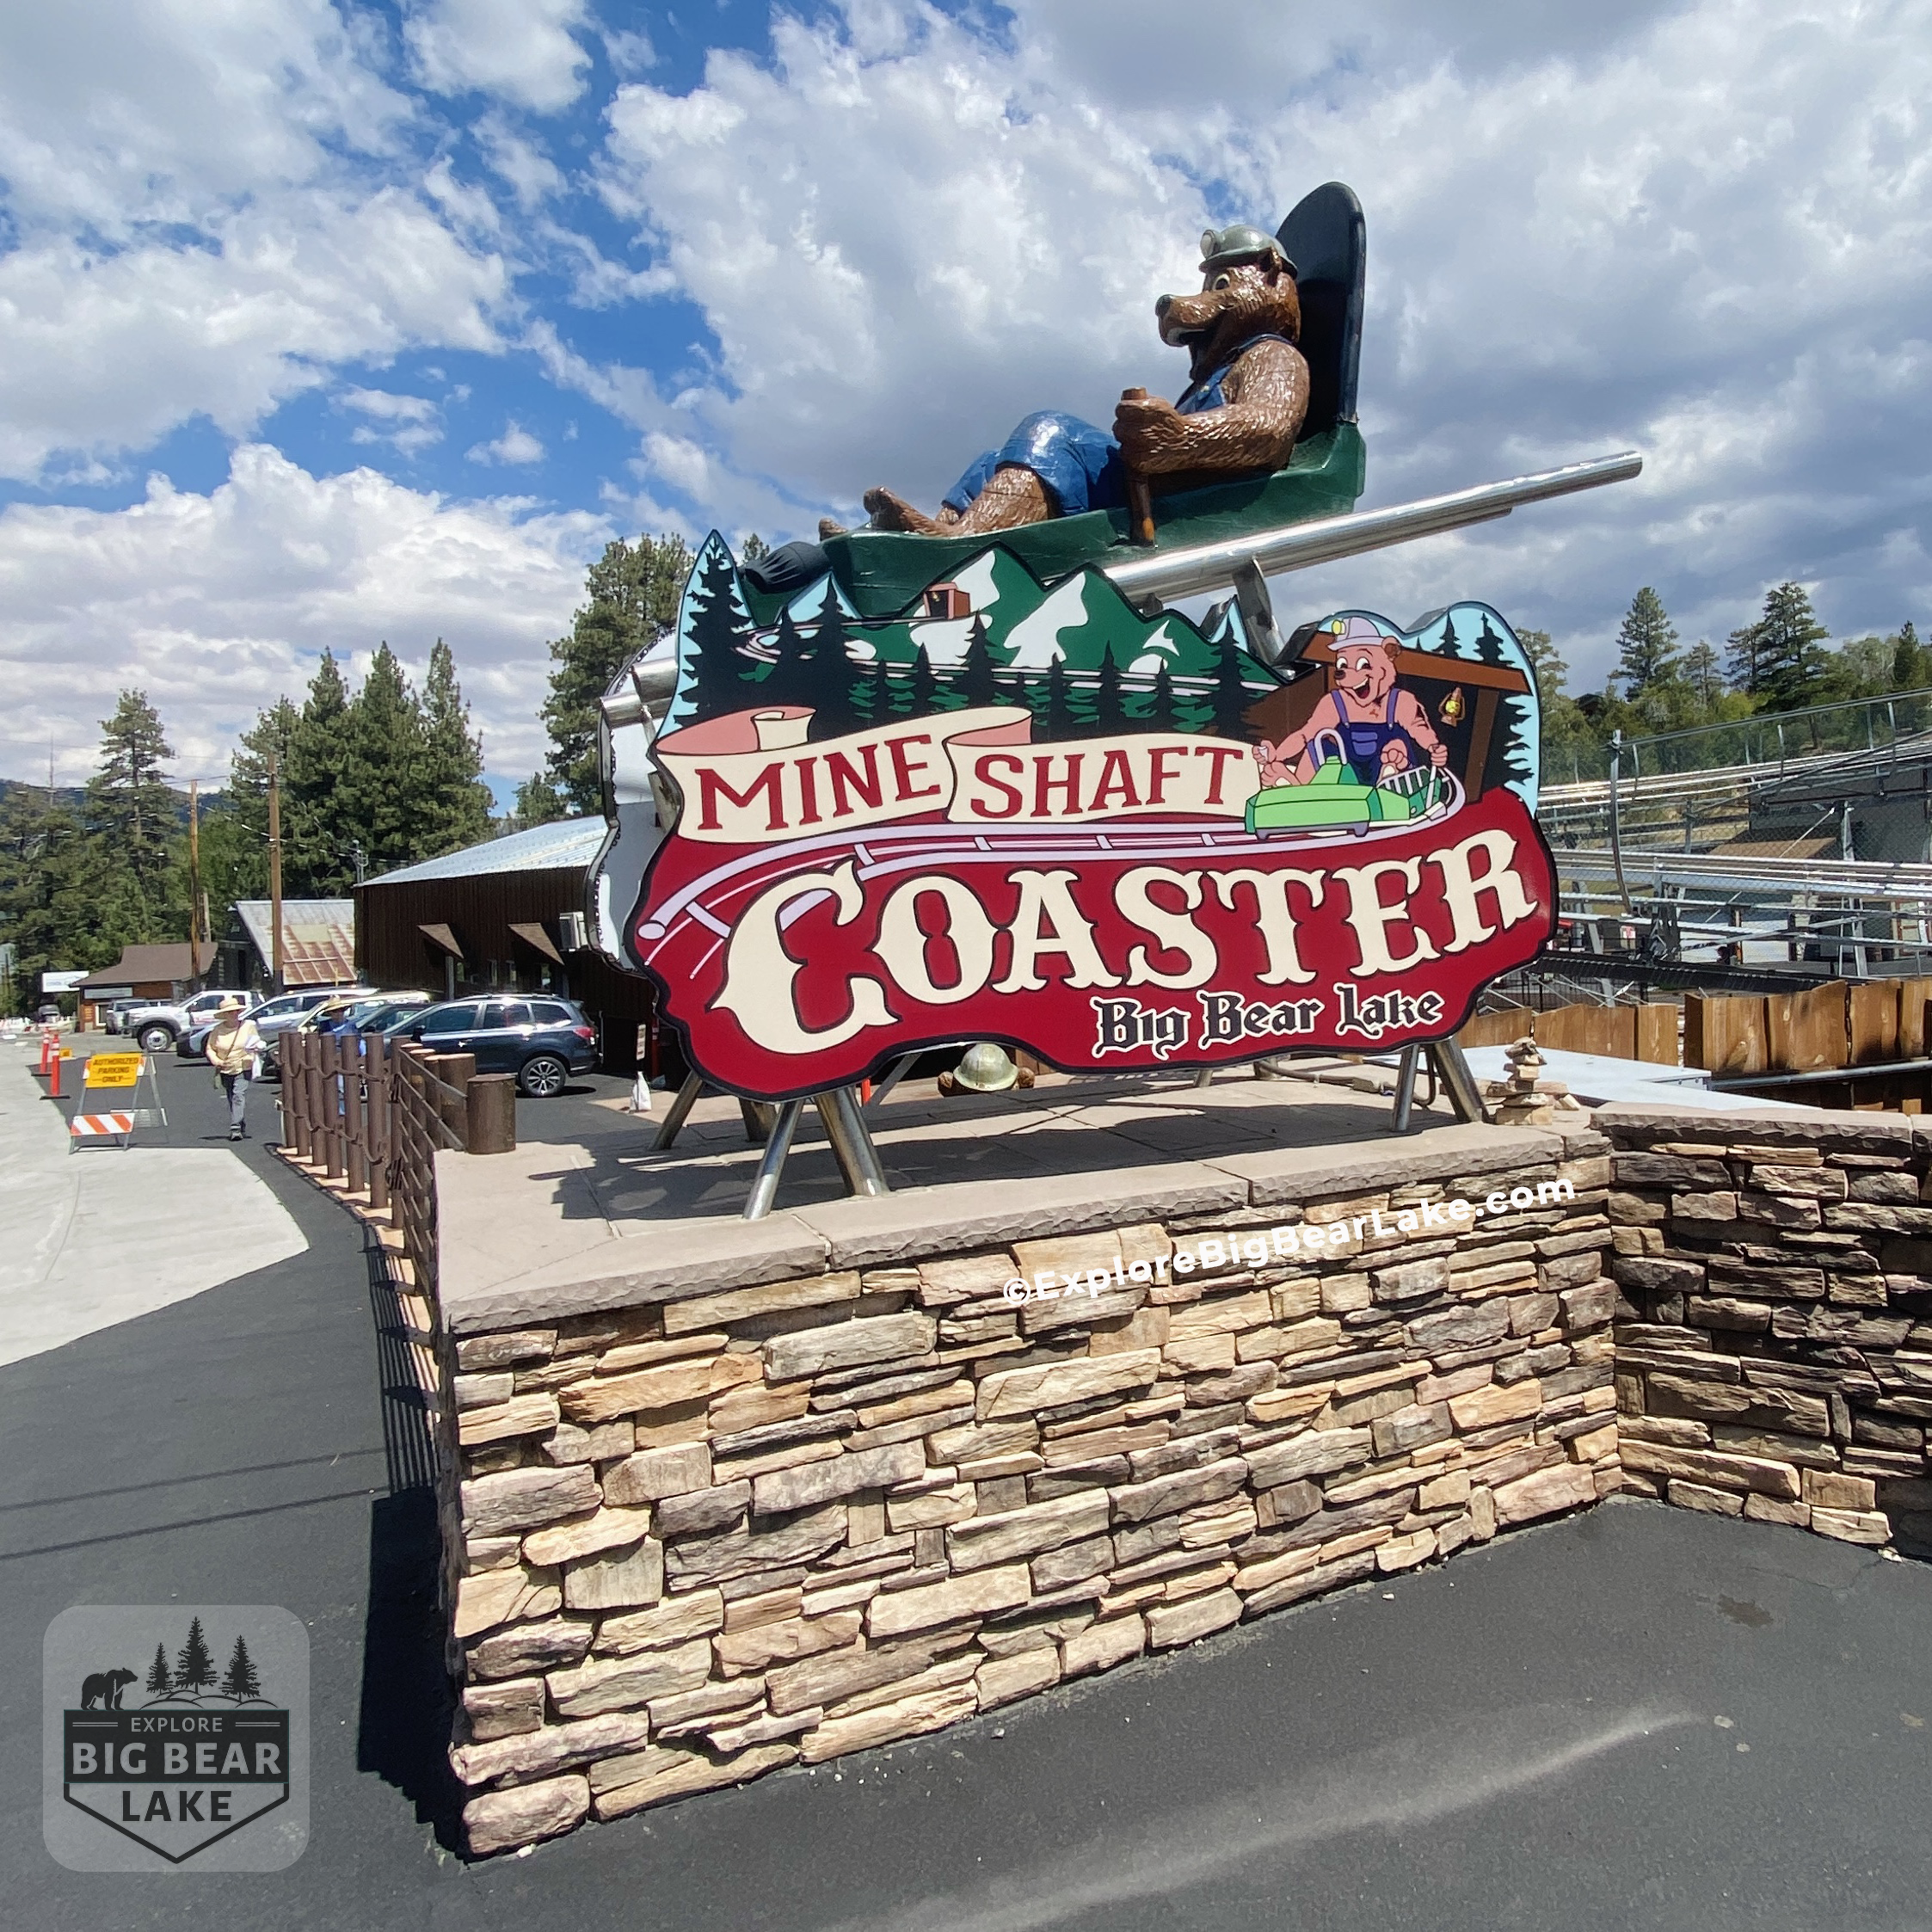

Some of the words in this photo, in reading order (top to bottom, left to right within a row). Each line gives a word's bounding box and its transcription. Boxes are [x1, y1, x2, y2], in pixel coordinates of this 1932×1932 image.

[695, 734, 941, 831] MINE
[970, 747, 1243, 819] SHAFT
[710, 829, 1538, 1055] COASTER
[93, 1057, 138, 1066] AUTHORIZED
[1090, 997, 1191, 1059] Big
[1198, 990, 1323, 1049] Bear
[1333, 983, 1444, 1039] Lake
